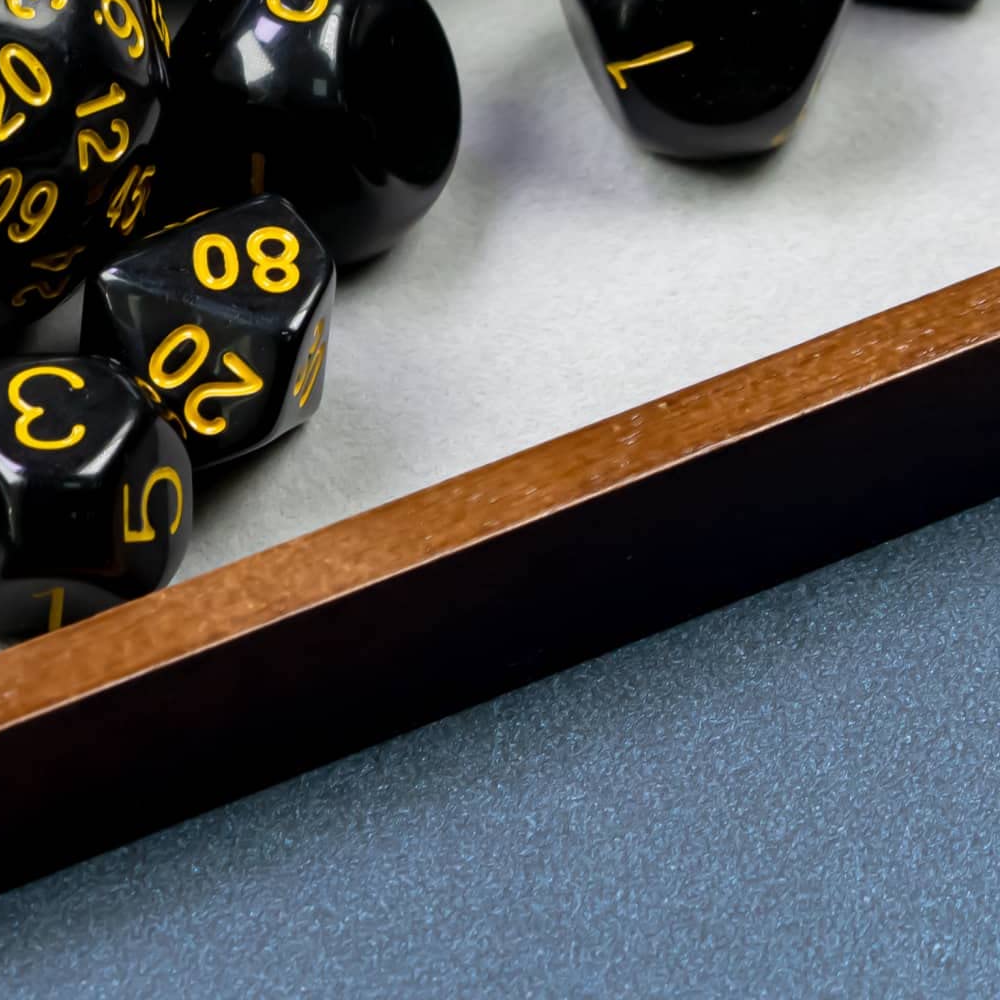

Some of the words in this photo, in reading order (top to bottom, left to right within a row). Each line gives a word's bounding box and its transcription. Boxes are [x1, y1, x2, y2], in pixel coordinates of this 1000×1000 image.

[75, 82, 129, 172] 12
[7, 364, 86, 451] 3
[148, 324, 264, 439] 20
[123, 466, 183, 543] 5
